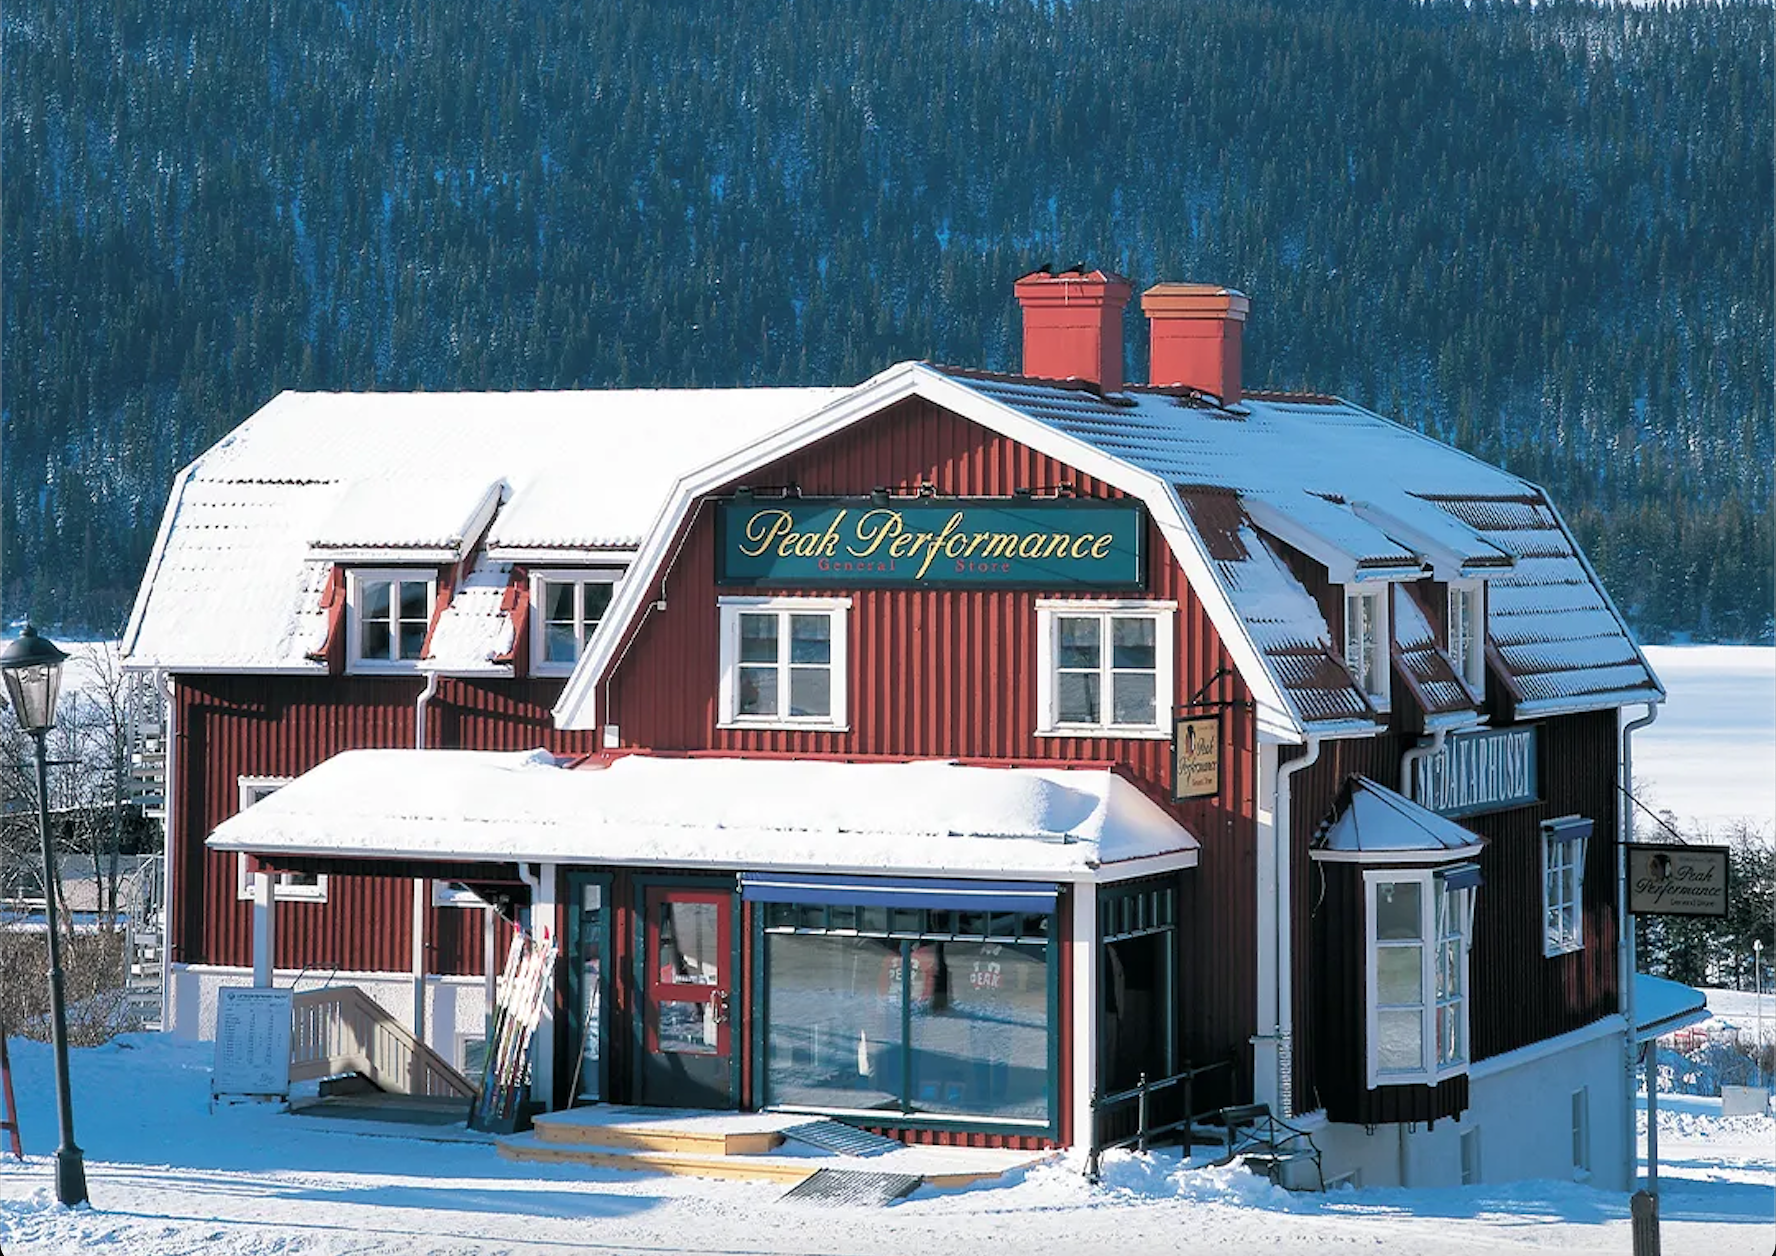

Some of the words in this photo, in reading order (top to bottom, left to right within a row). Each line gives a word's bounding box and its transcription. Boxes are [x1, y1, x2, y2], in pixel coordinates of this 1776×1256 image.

[739, 508, 848, 558] Peak
[846, 508, 1113, 581] Performance
[818, 557, 896, 572] General
[954, 559, 1011, 573] Store
[1674, 865, 1715, 882] Peak
[1634, 877, 1723, 905] Performance
